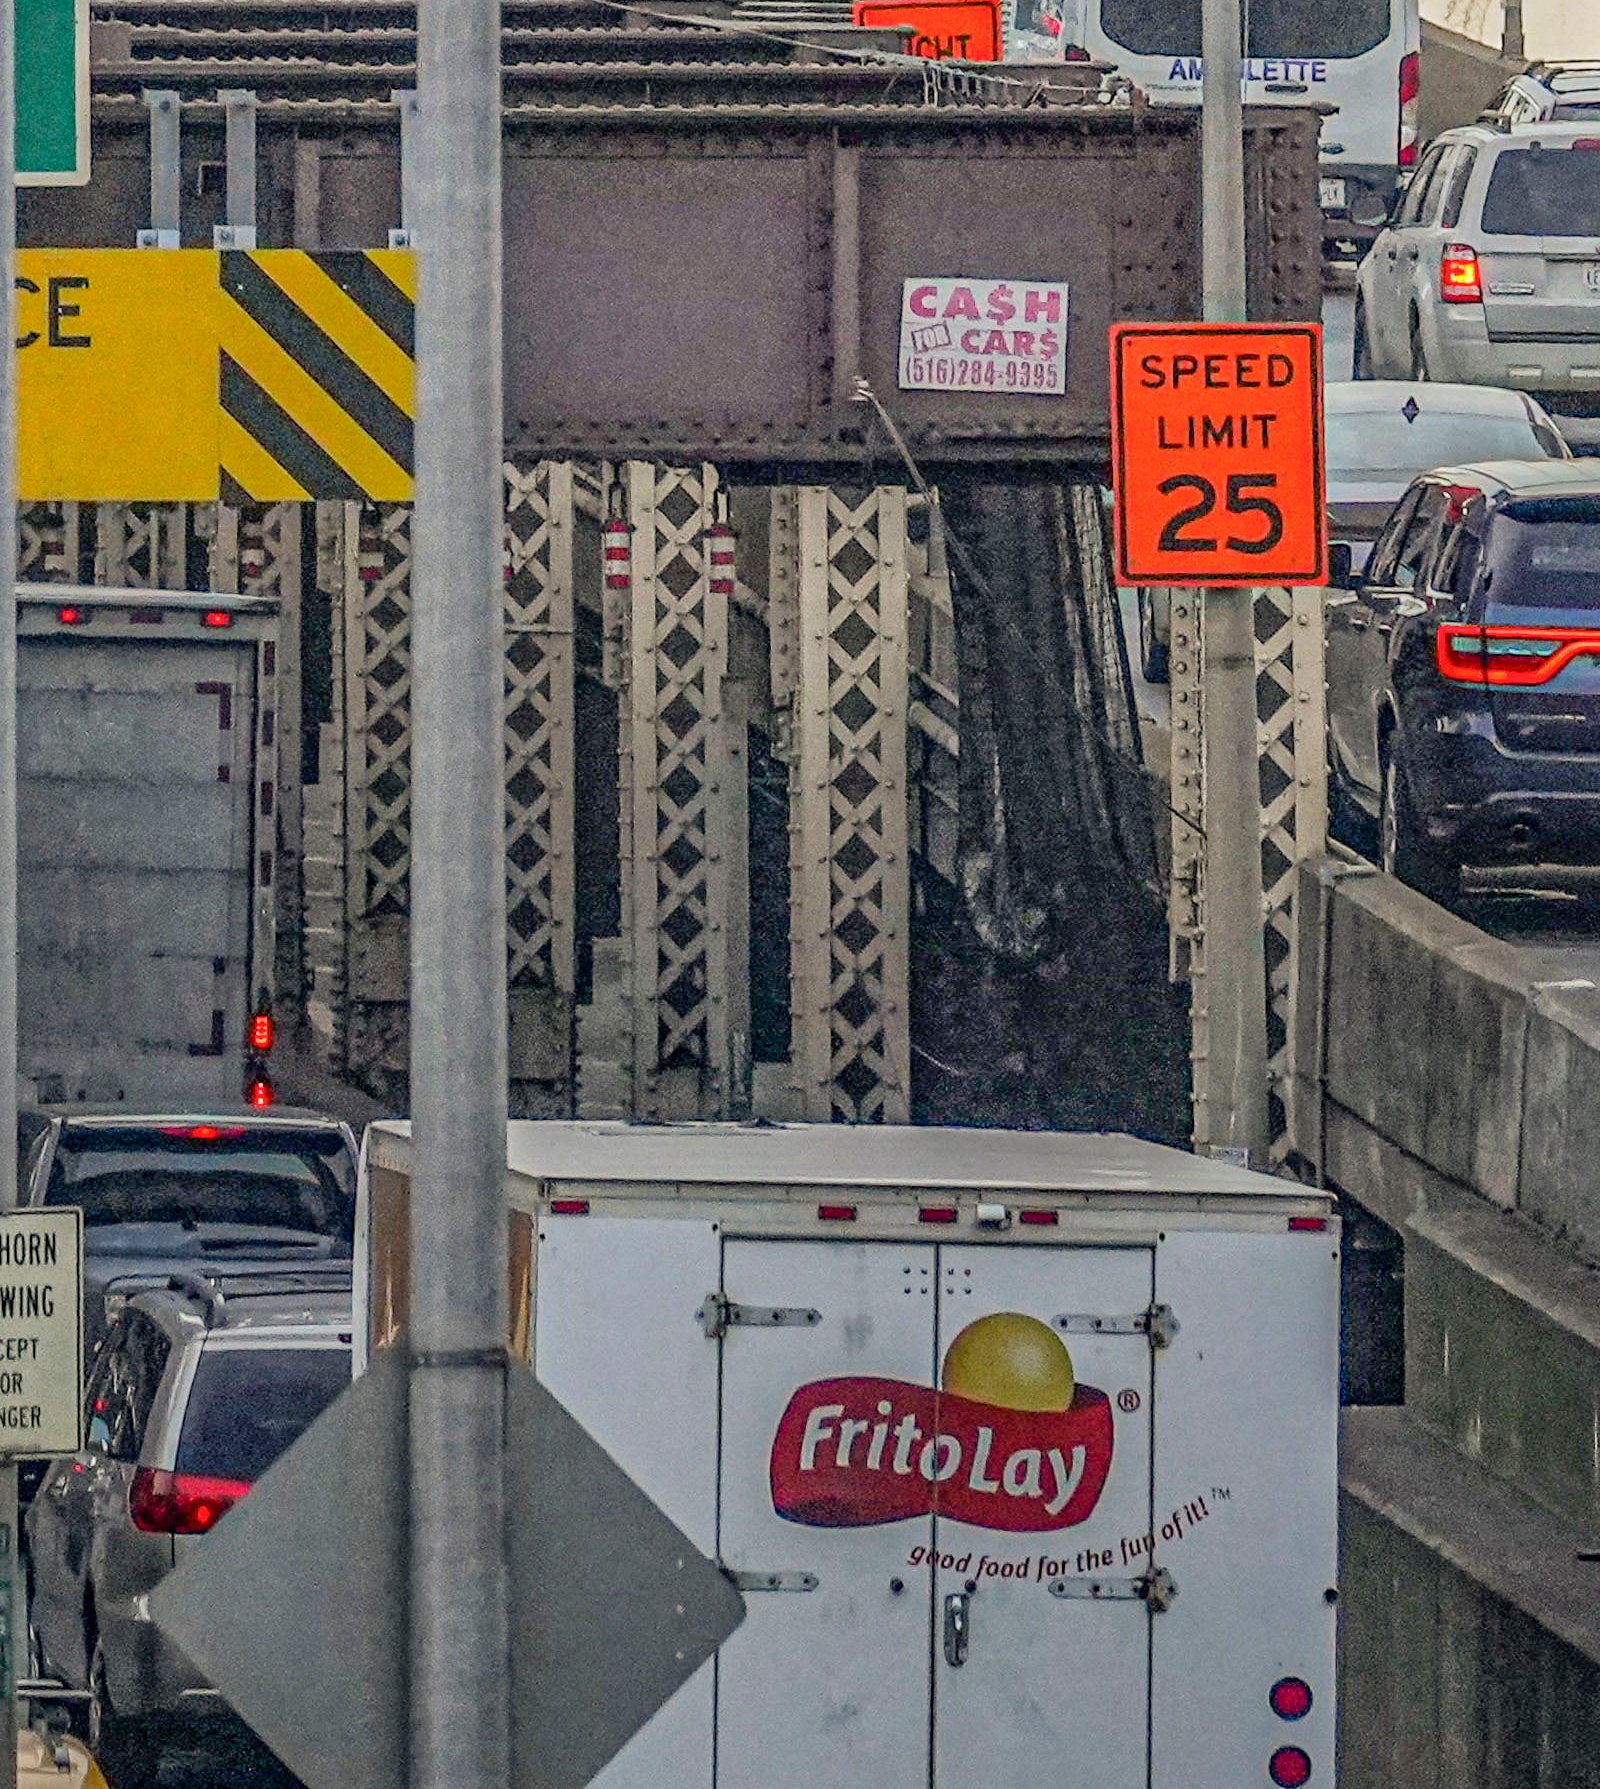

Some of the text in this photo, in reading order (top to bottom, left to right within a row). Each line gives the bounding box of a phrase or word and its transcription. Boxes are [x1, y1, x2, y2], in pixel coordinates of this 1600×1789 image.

[1140, 353, 1295, 390] SPEED
[1157, 413, 1277, 450] LIMIT
[1156, 473, 1284, 555] 25
[908, 1544, 973, 1573] good
[974, 1555, 1031, 1581] food
[1036, 1557, 1070, 1584] for
[1076, 1548, 1113, 1573] the
[1120, 1532, 1156, 1565] fun
[1161, 1508, 1184, 1540] of
[1184, 1496, 1210, 1527] it!
